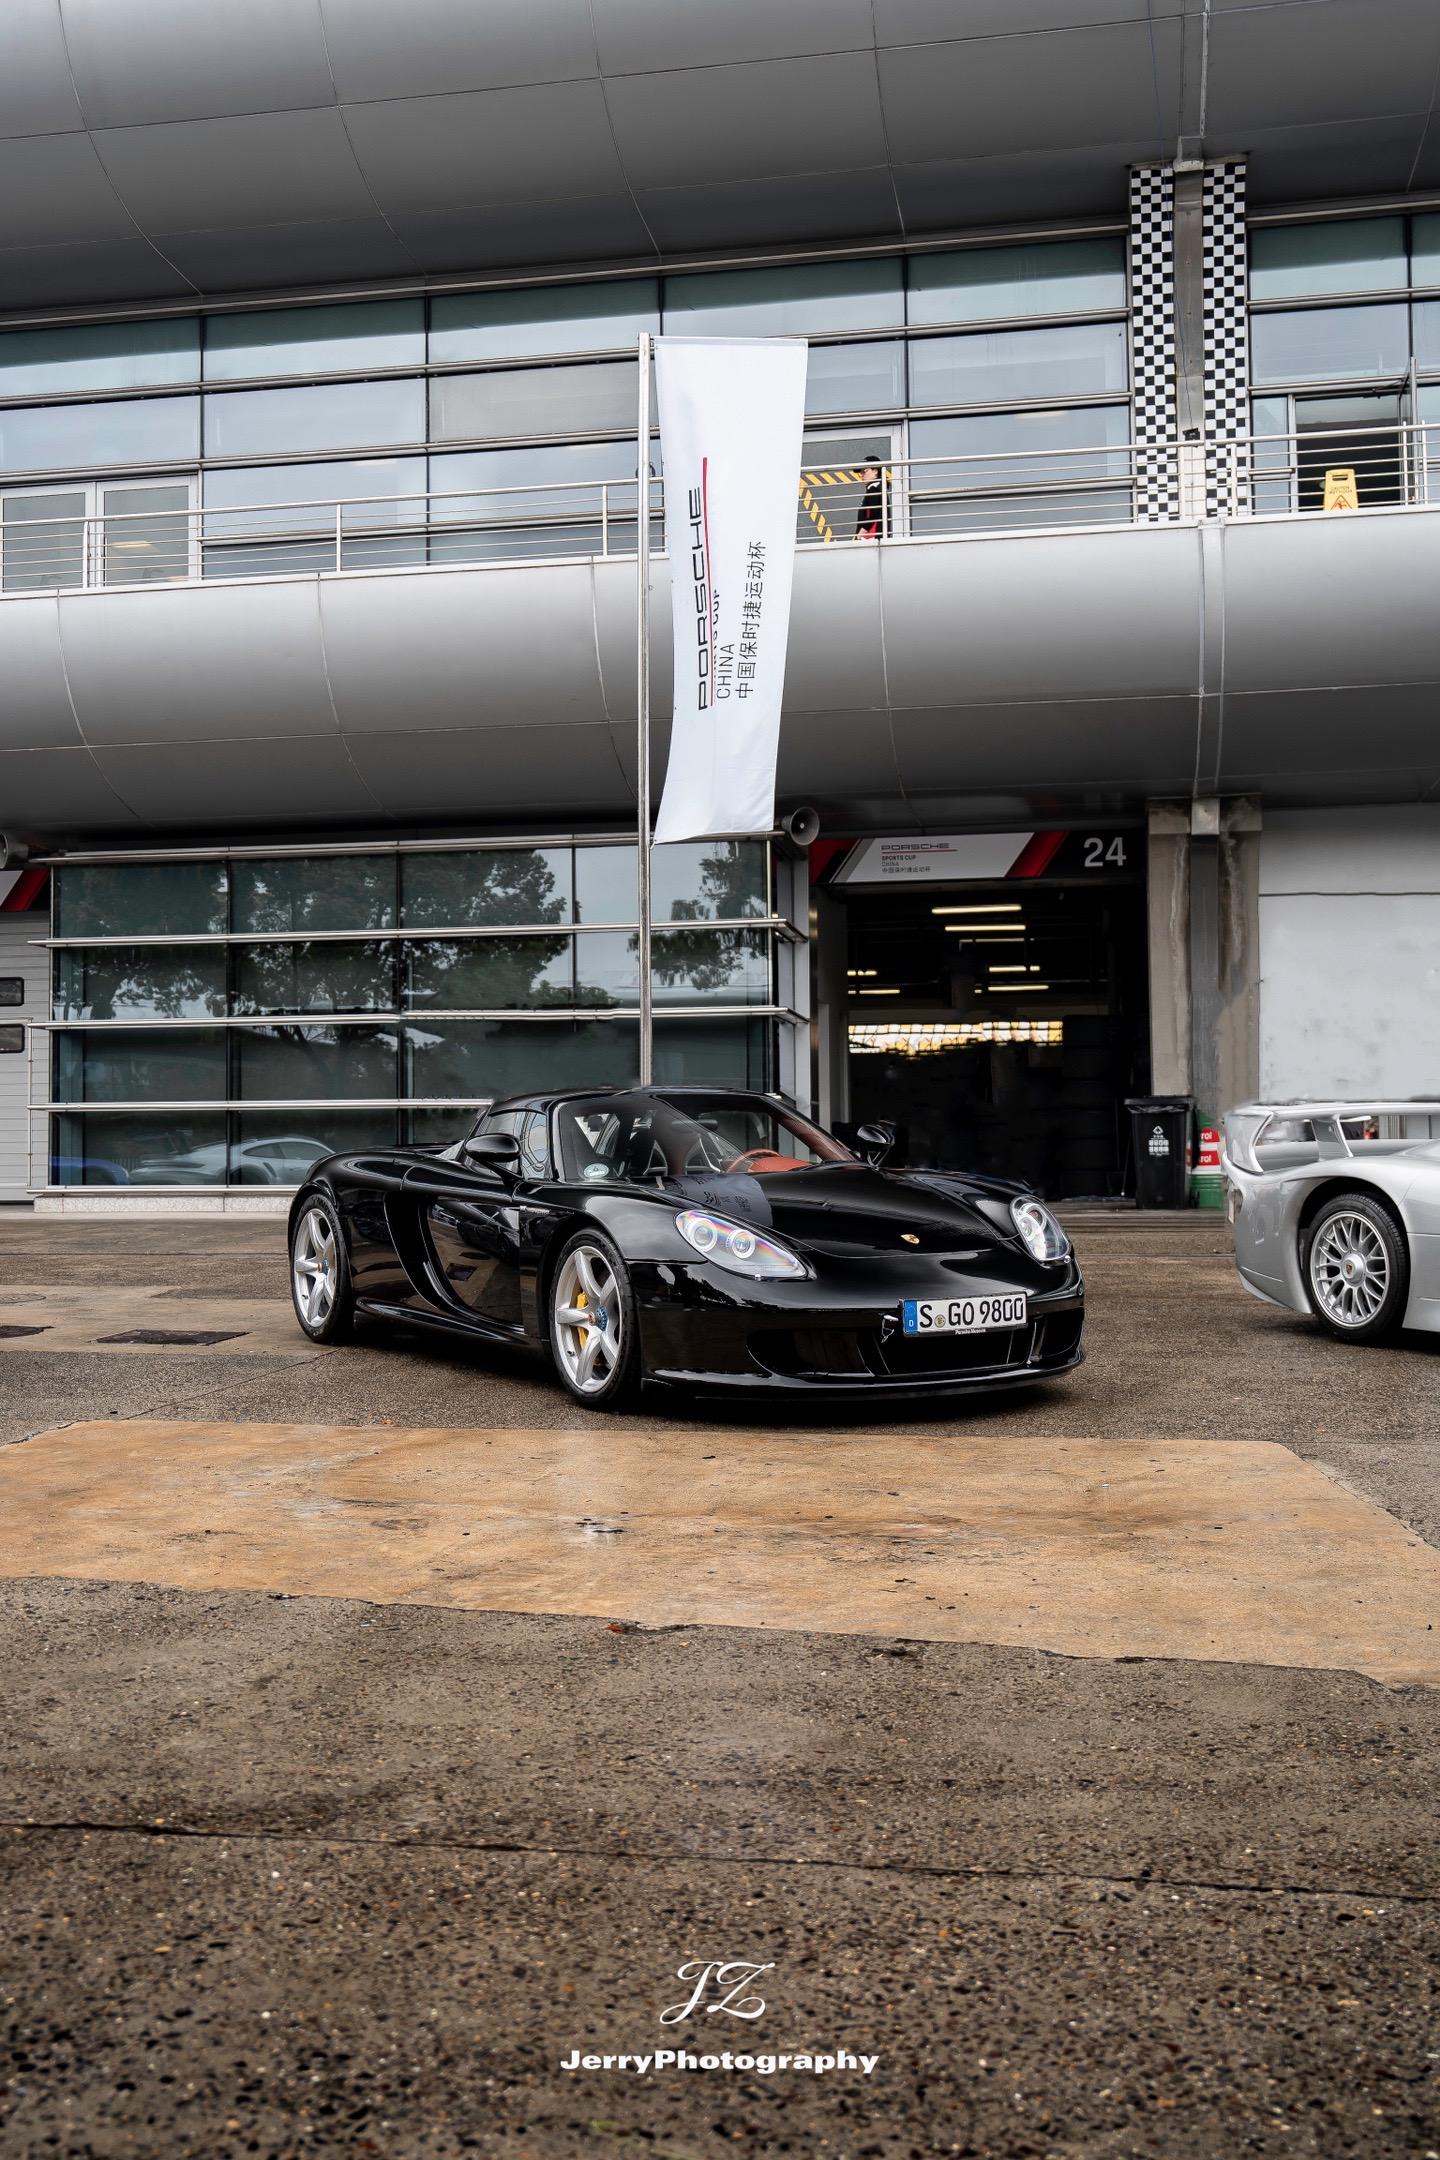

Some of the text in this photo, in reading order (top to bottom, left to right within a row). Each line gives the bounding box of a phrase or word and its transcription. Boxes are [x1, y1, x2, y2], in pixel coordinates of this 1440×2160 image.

[688, 487, 709, 711] PORSCHE
[735, 541, 766, 698] 中国保时捷运动杯
[716, 643, 735, 699] CHINA
[1083, 837, 1127, 867] 24
[919, 1304, 933, 1328] S
[948, 1301, 975, 1326] GO
[979, 1298, 1024, 1324] 9800
